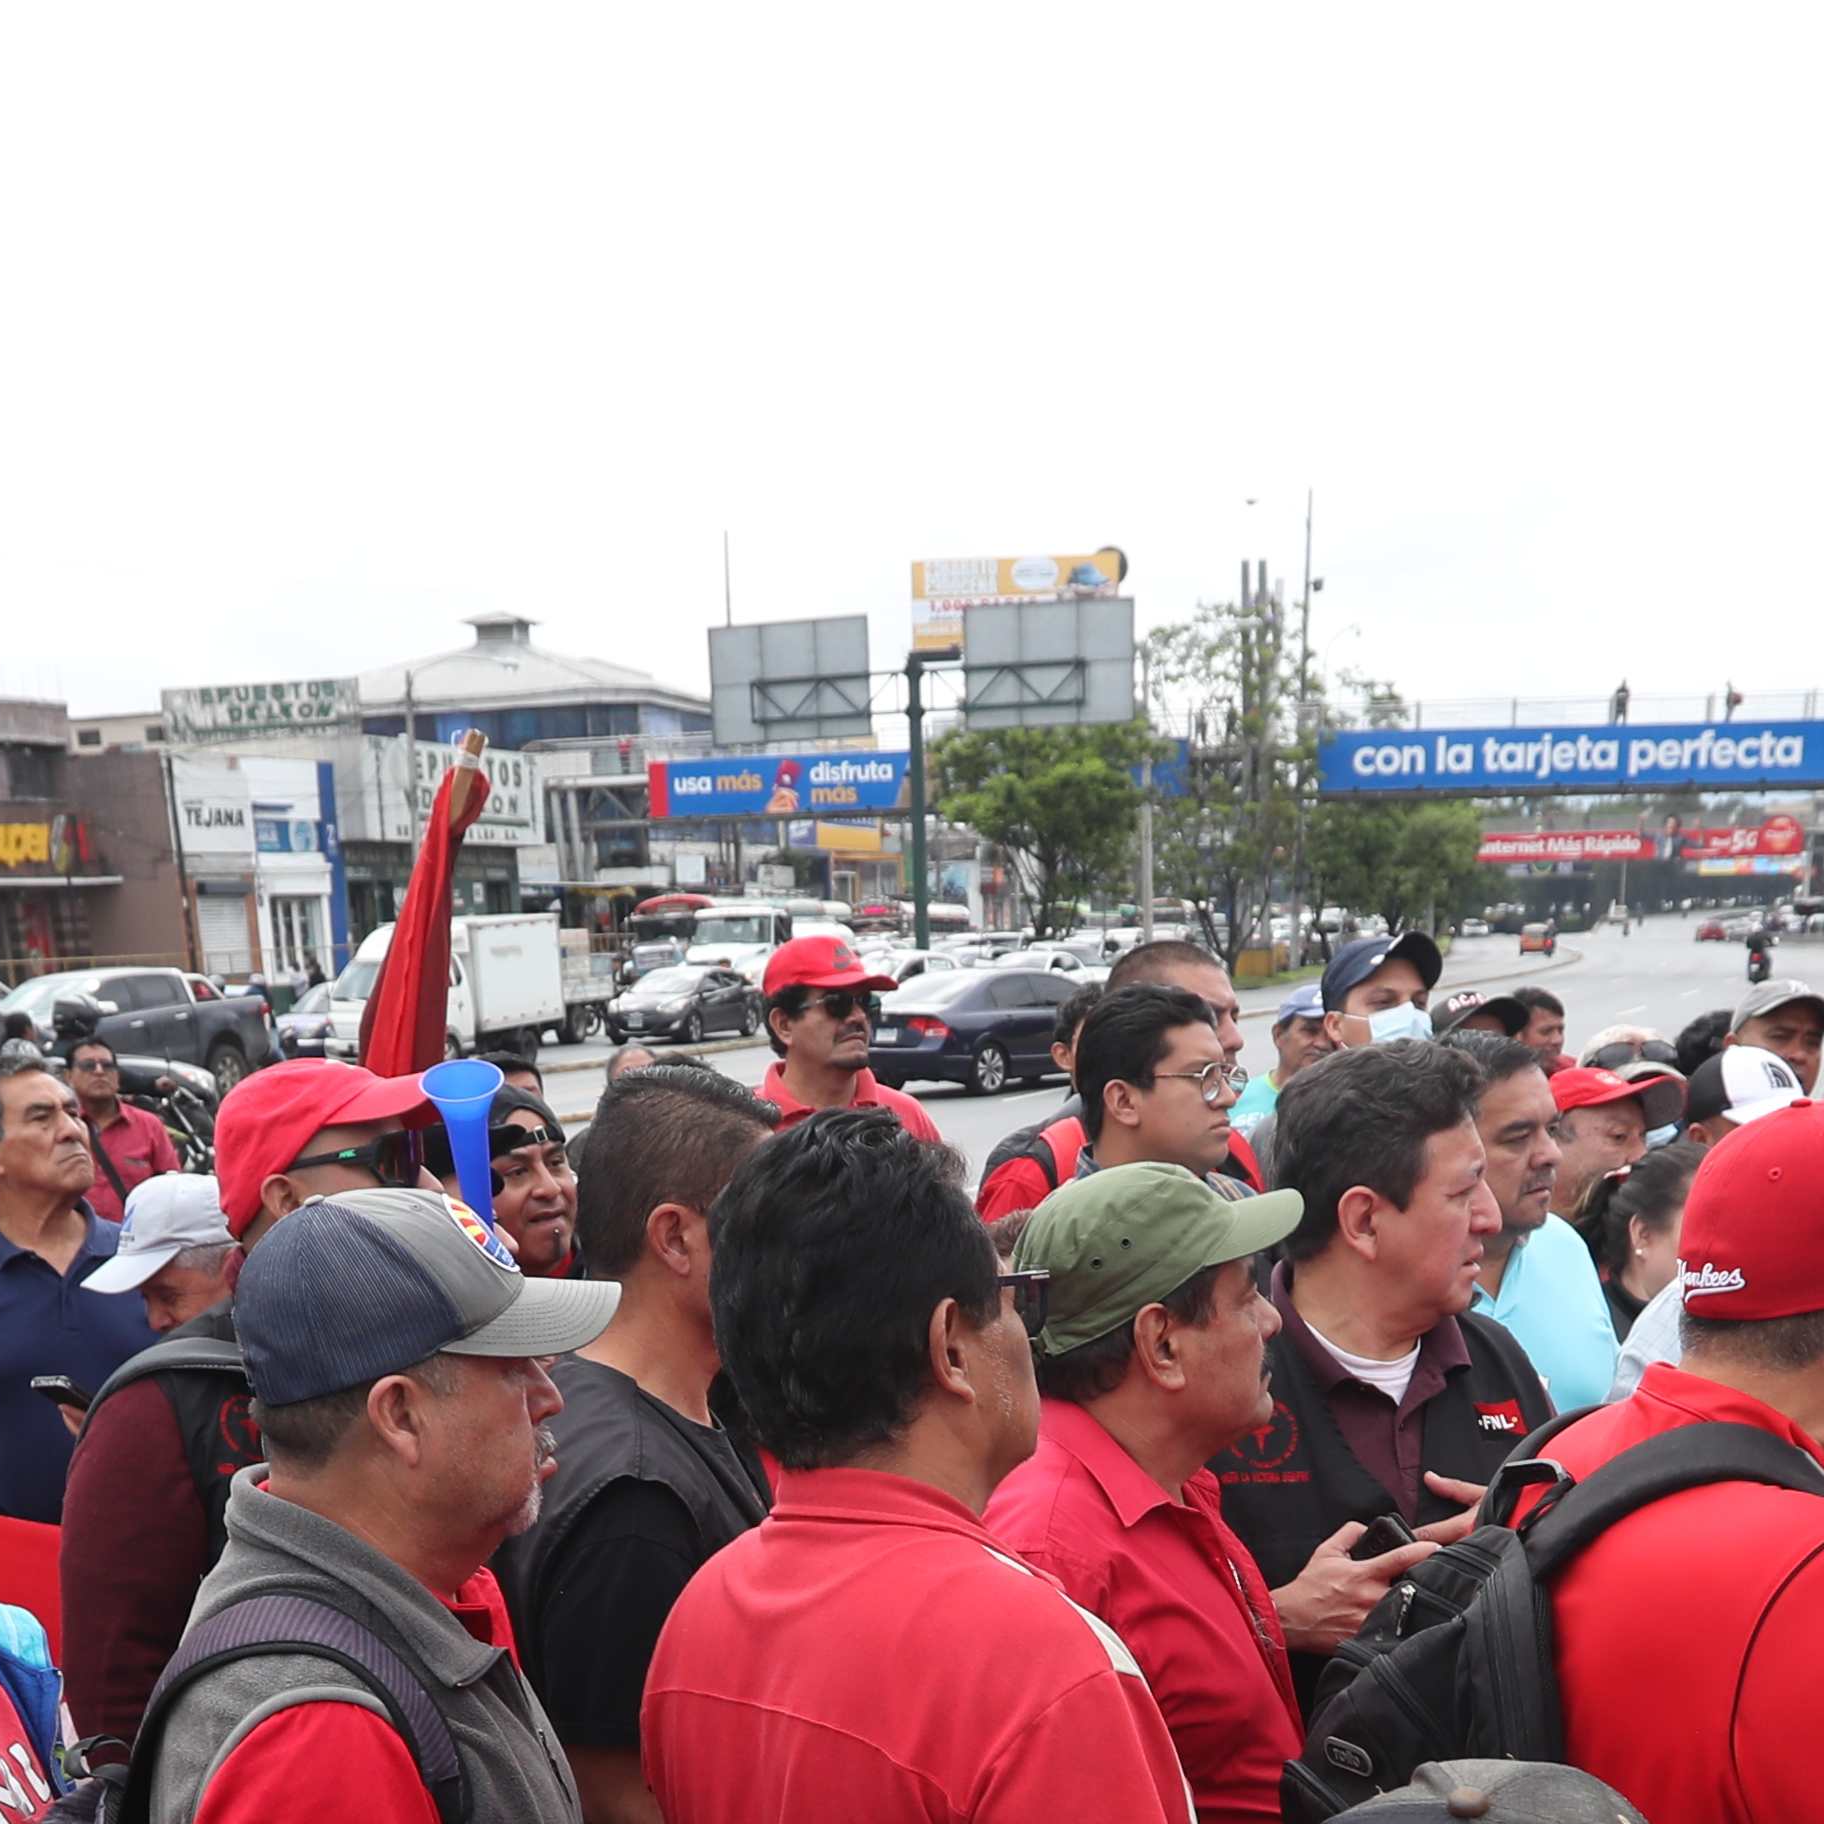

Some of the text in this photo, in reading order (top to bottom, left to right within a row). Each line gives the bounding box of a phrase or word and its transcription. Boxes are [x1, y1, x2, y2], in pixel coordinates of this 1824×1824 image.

[1352, 729, 1804, 778] con la tarjeta perfecta
[673, 768, 764, 795] usa más
[809, 760, 894, 784] disfruta
[811, 781, 858, 804] más
[183, 805, 245, 828] TEJANA
[1584, 833, 1642, 855] Rápido
[1730, 826, 1759, 852] 5G
[1676, 1258, 1744, 1301] Yankees
[1481, 1413, 1516, 1431] FNL
